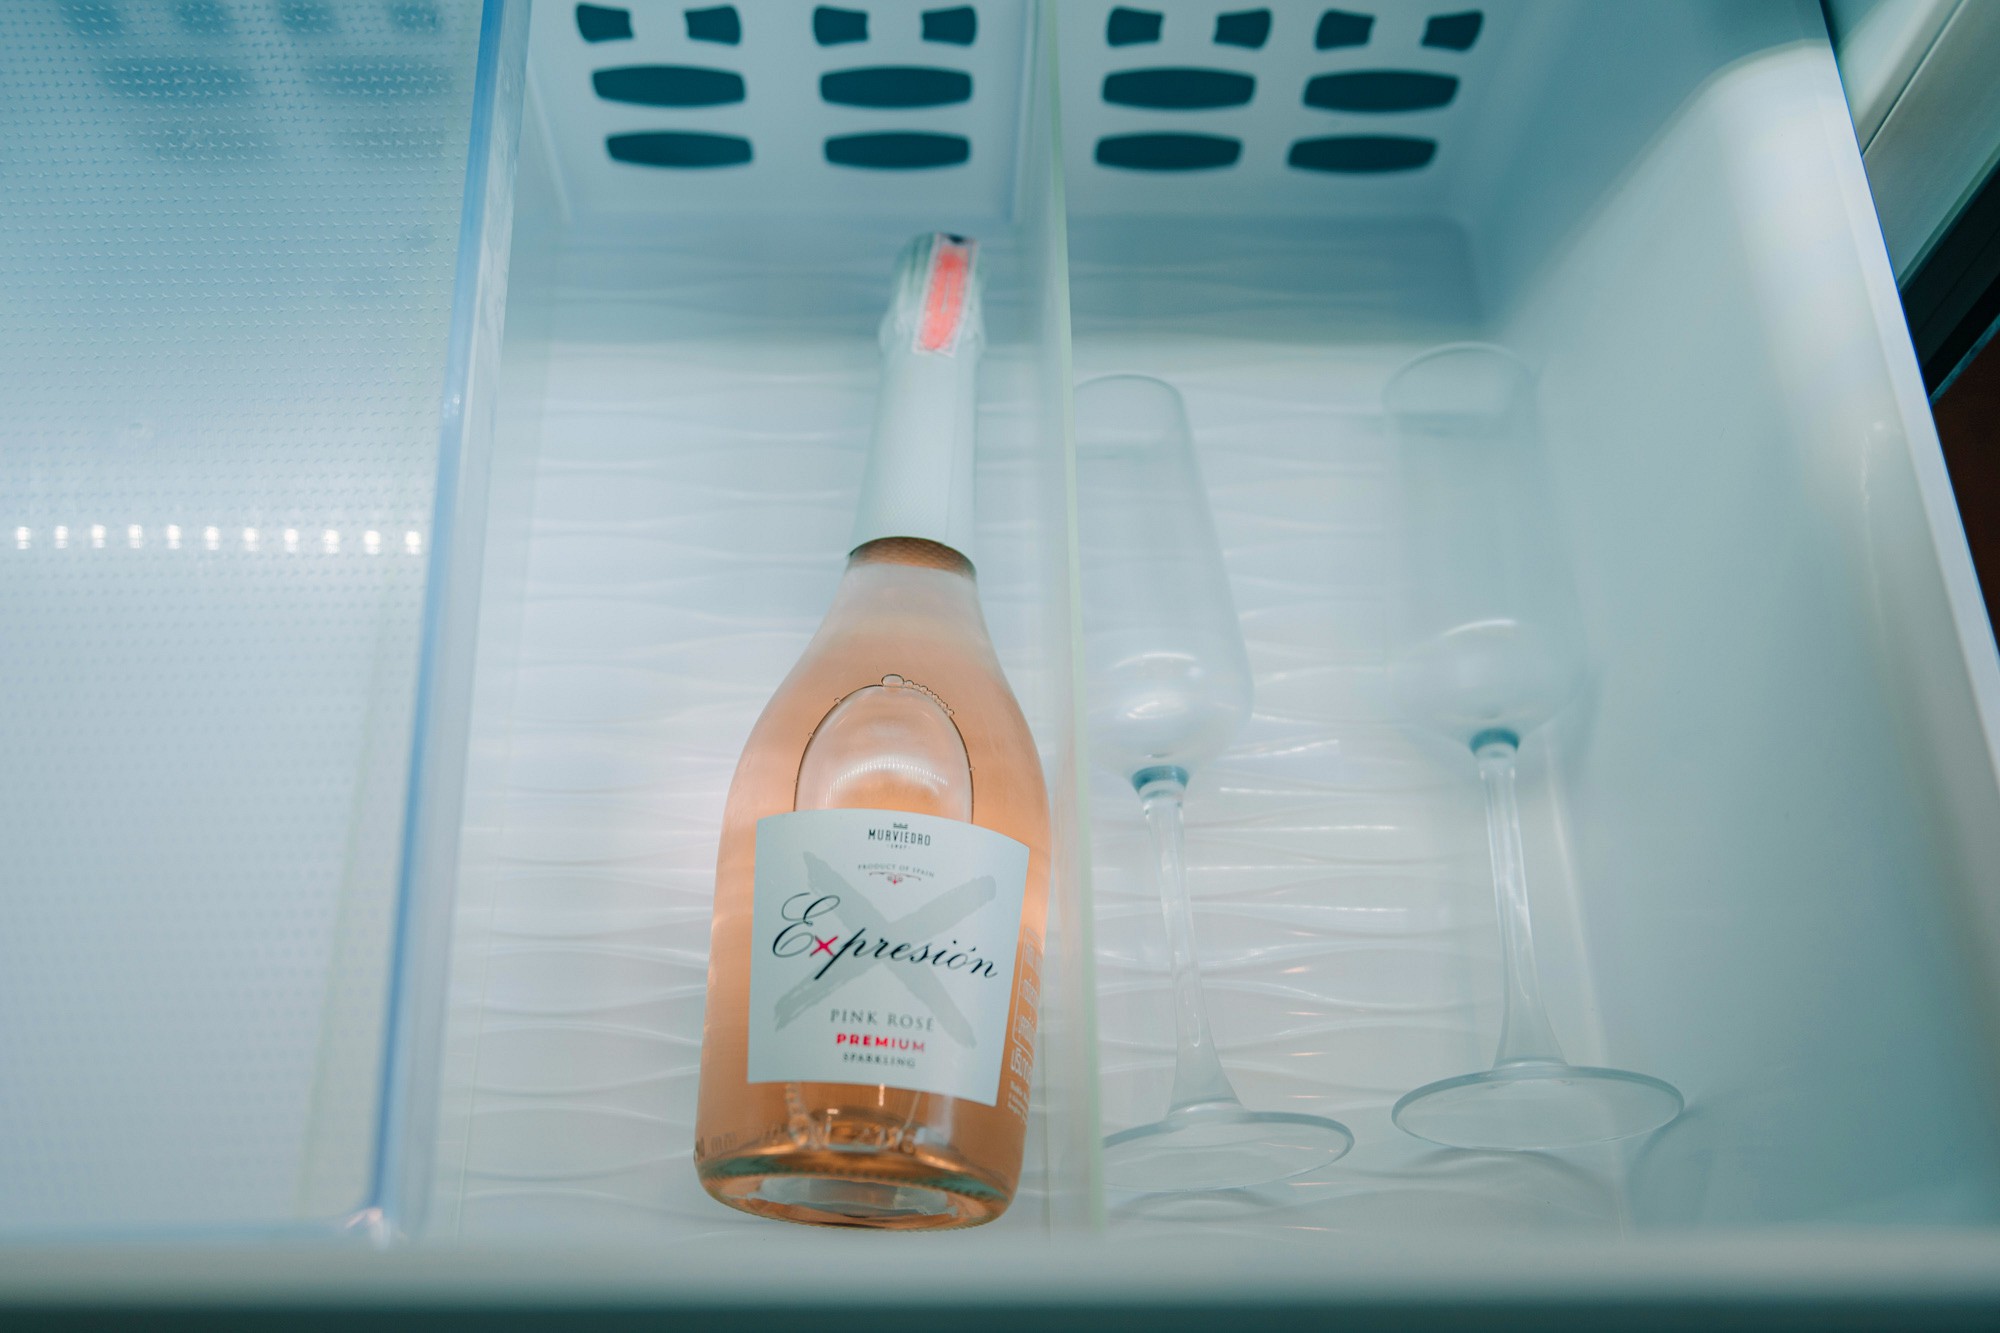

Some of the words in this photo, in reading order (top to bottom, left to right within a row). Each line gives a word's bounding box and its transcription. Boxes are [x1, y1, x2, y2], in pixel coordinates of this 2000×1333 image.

[867, 828, 931, 846] MURVIEDRO
[772, 892, 998, 980] Expresión
[830, 1008, 877, 1026] PINK
[836, 1033, 925, 1051] PREMIUM
[843, 1052, 915, 1067] SPARKLING
